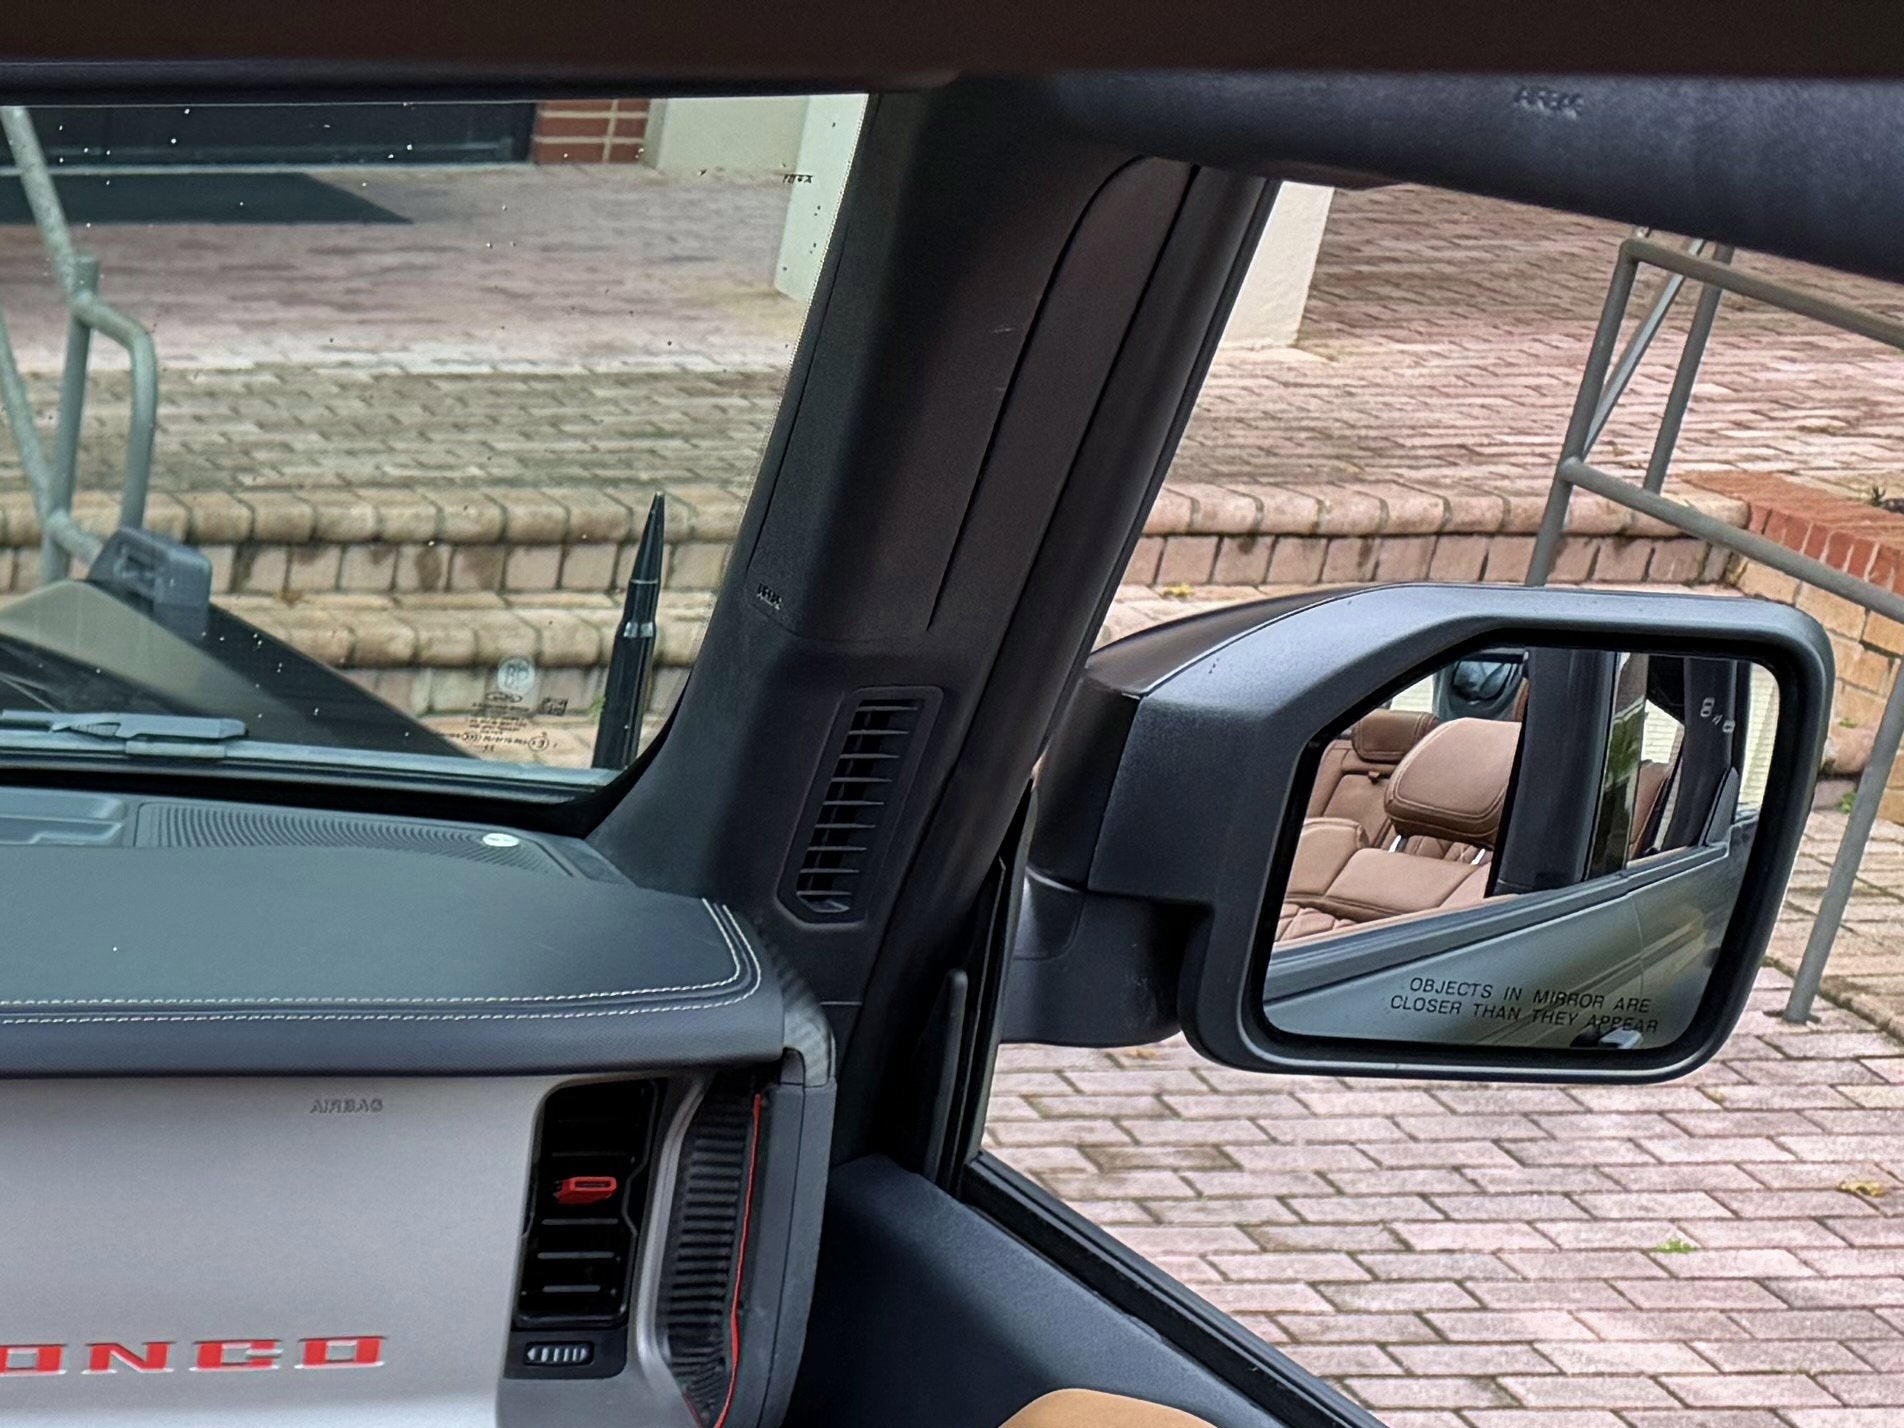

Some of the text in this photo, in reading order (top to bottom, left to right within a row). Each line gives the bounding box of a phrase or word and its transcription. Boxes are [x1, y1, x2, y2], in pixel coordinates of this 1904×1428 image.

[1409, 977, 1651, 1014] OBJECTS IN MIRROR ARE
[1390, 995, 1659, 1034] CLOSER THAN THEY APPEAR
[309, 1098, 384, 1114] AIRBAG
